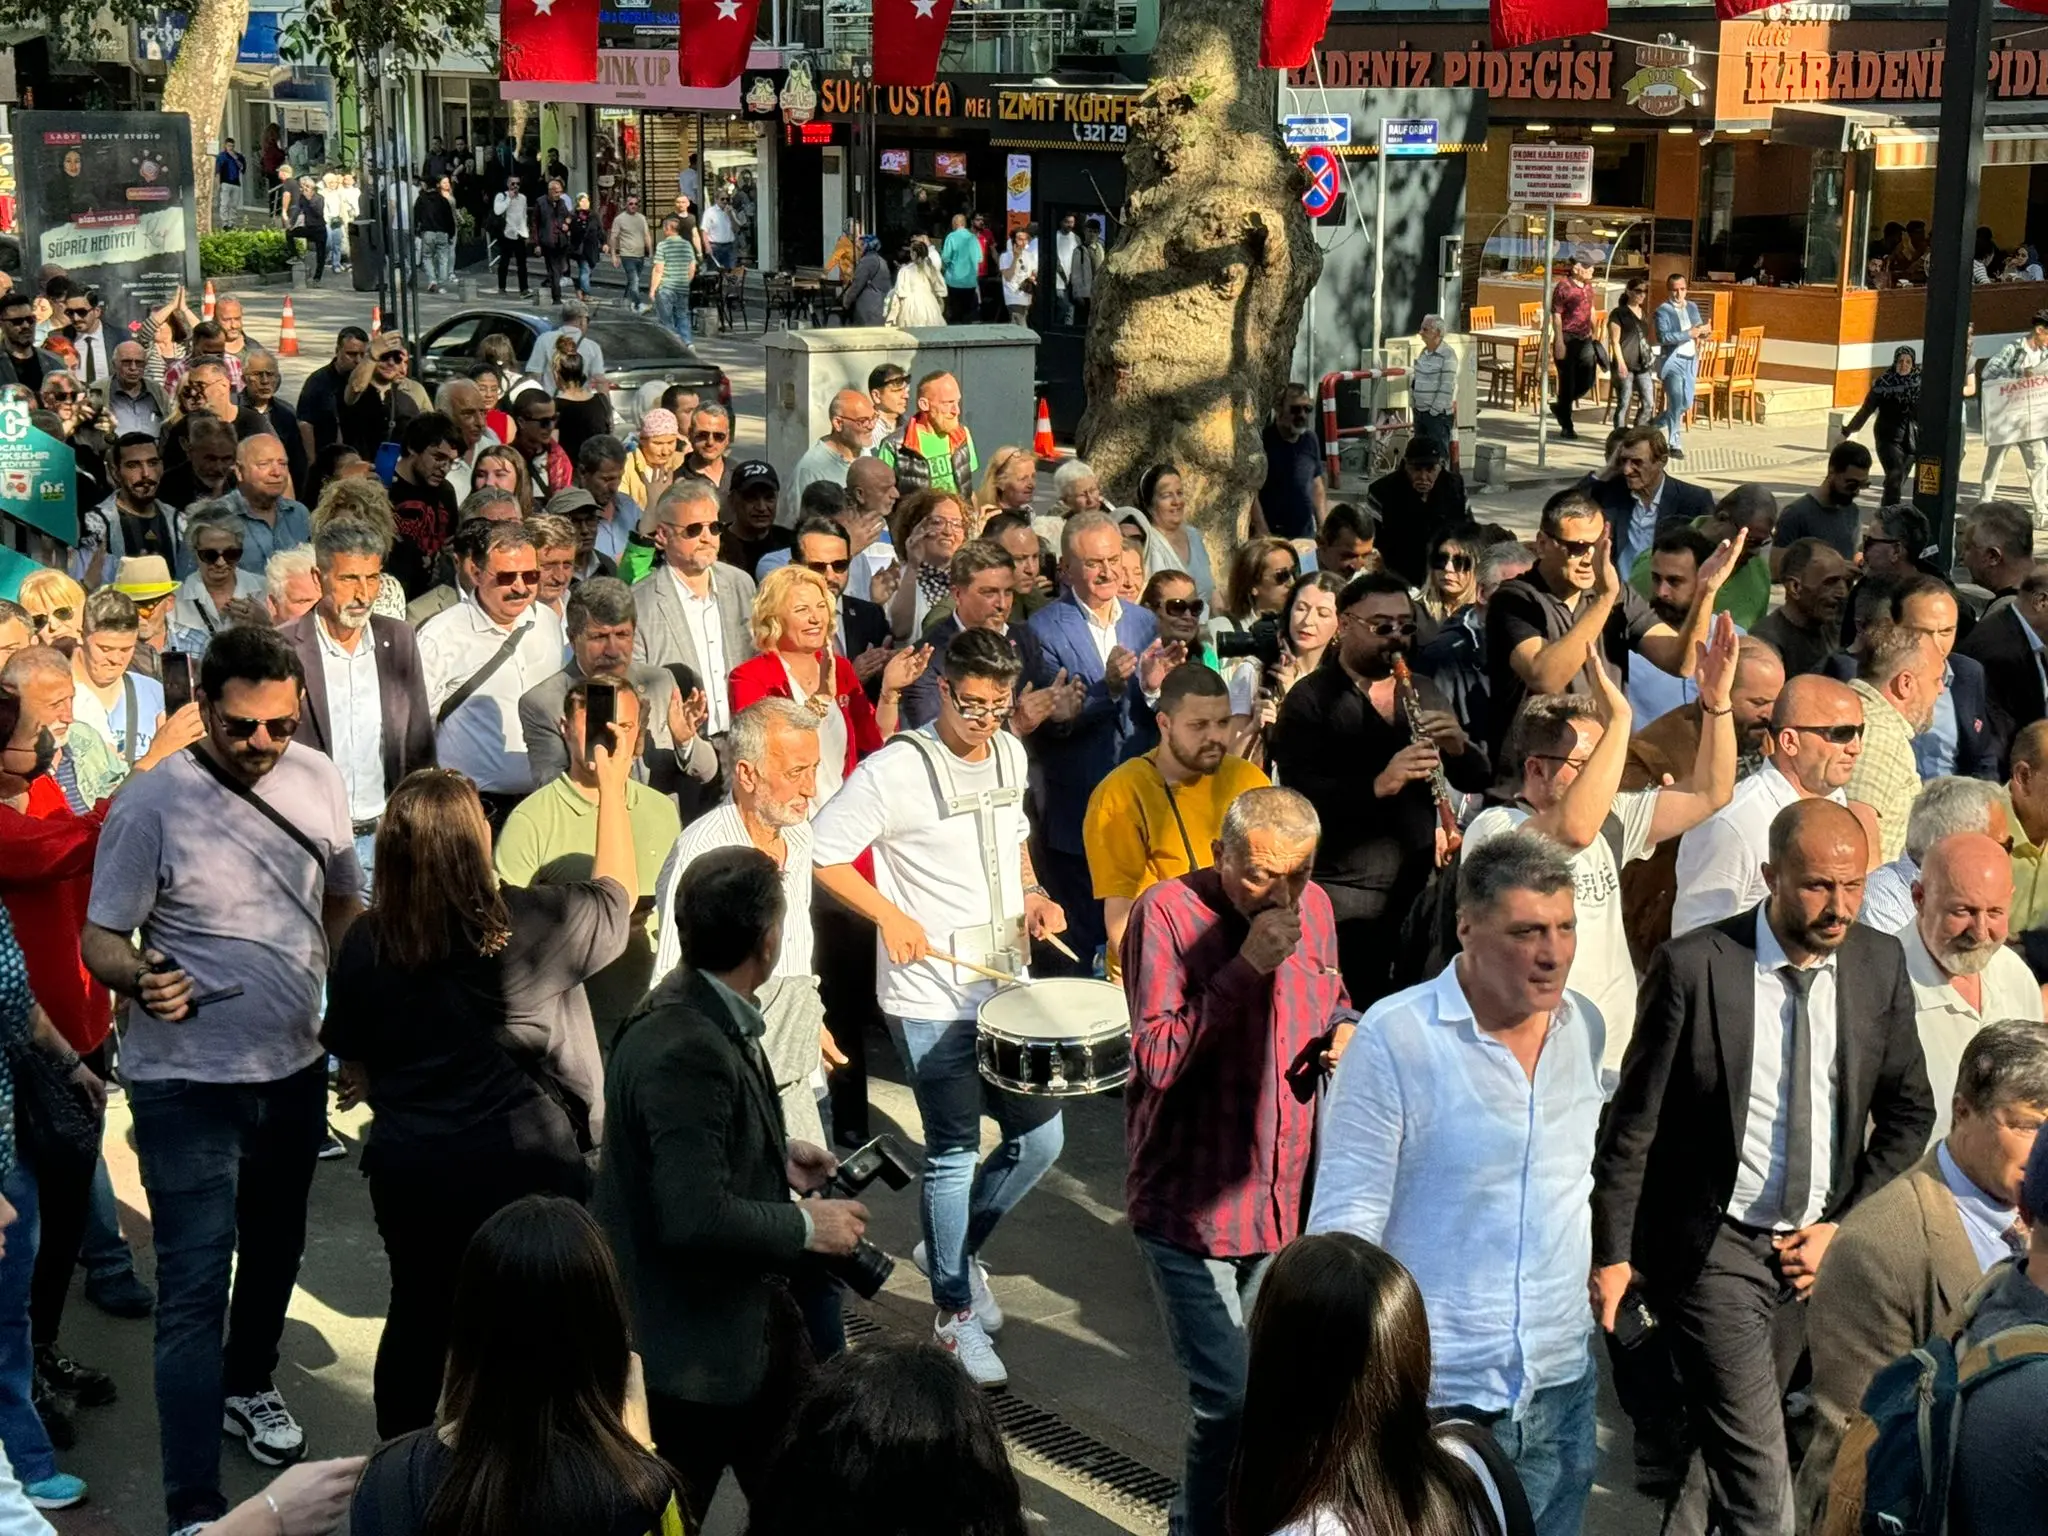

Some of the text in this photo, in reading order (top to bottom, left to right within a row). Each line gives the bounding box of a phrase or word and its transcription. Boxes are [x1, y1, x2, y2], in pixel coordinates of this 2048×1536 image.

[643, 57, 671, 86] UP
[1443, 39, 1613, 100] PİDECİSİ
[1748, 38, 1945, 100] KARADENİ
[888, 82, 951, 118] USTA
[999, 91, 1060, 121] İZMİT
[1083, 124, 1105, 141] 321
[48, 227, 136, 258] SÜPRİZ HEDİYEYİ
